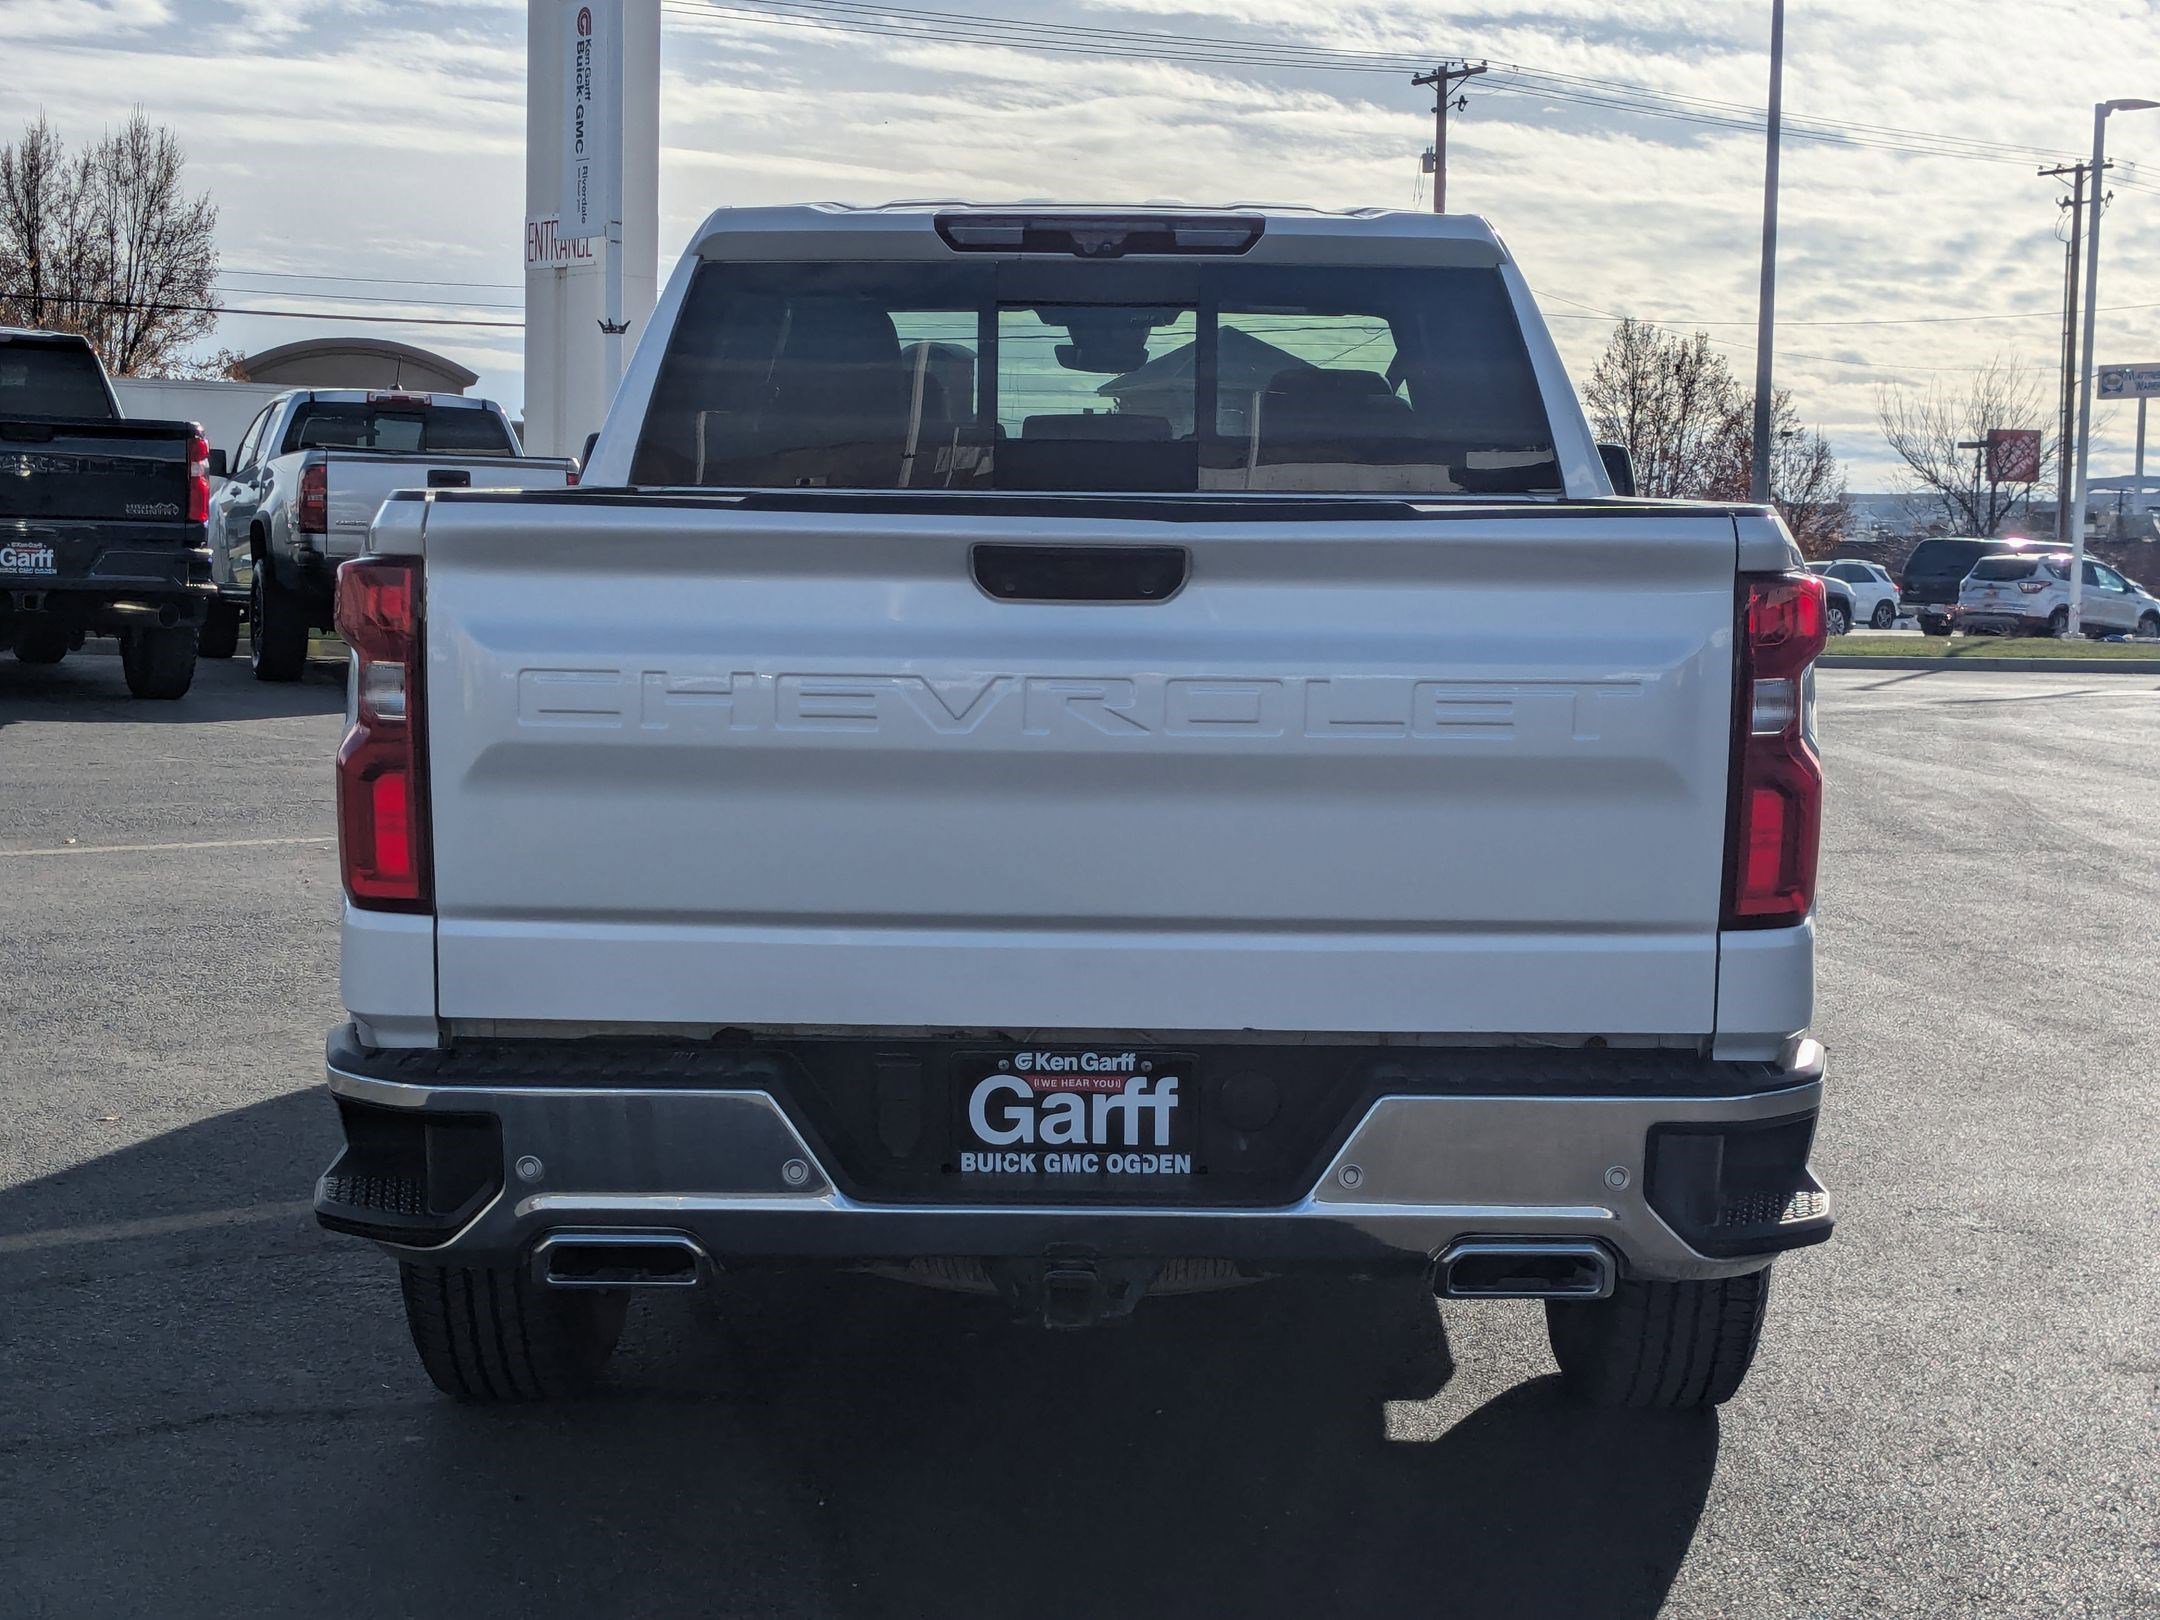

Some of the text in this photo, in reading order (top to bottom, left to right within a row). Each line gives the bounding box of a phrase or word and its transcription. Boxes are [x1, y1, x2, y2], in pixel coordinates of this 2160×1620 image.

[584, 67, 592, 101] Garff
[581, 165, 589, 224] Riverdale
[0, 547, 54, 568] Garff
[516, 667, 1643, 741] CHEVROLET
[1035, 1052, 1136, 1071] Ken Garff
[1061, 1079, 1090, 1088] HEAR
[968, 1074, 1179, 1146] Garff
[960, 1152, 1191, 1174] BUICK GMC OGDEN
